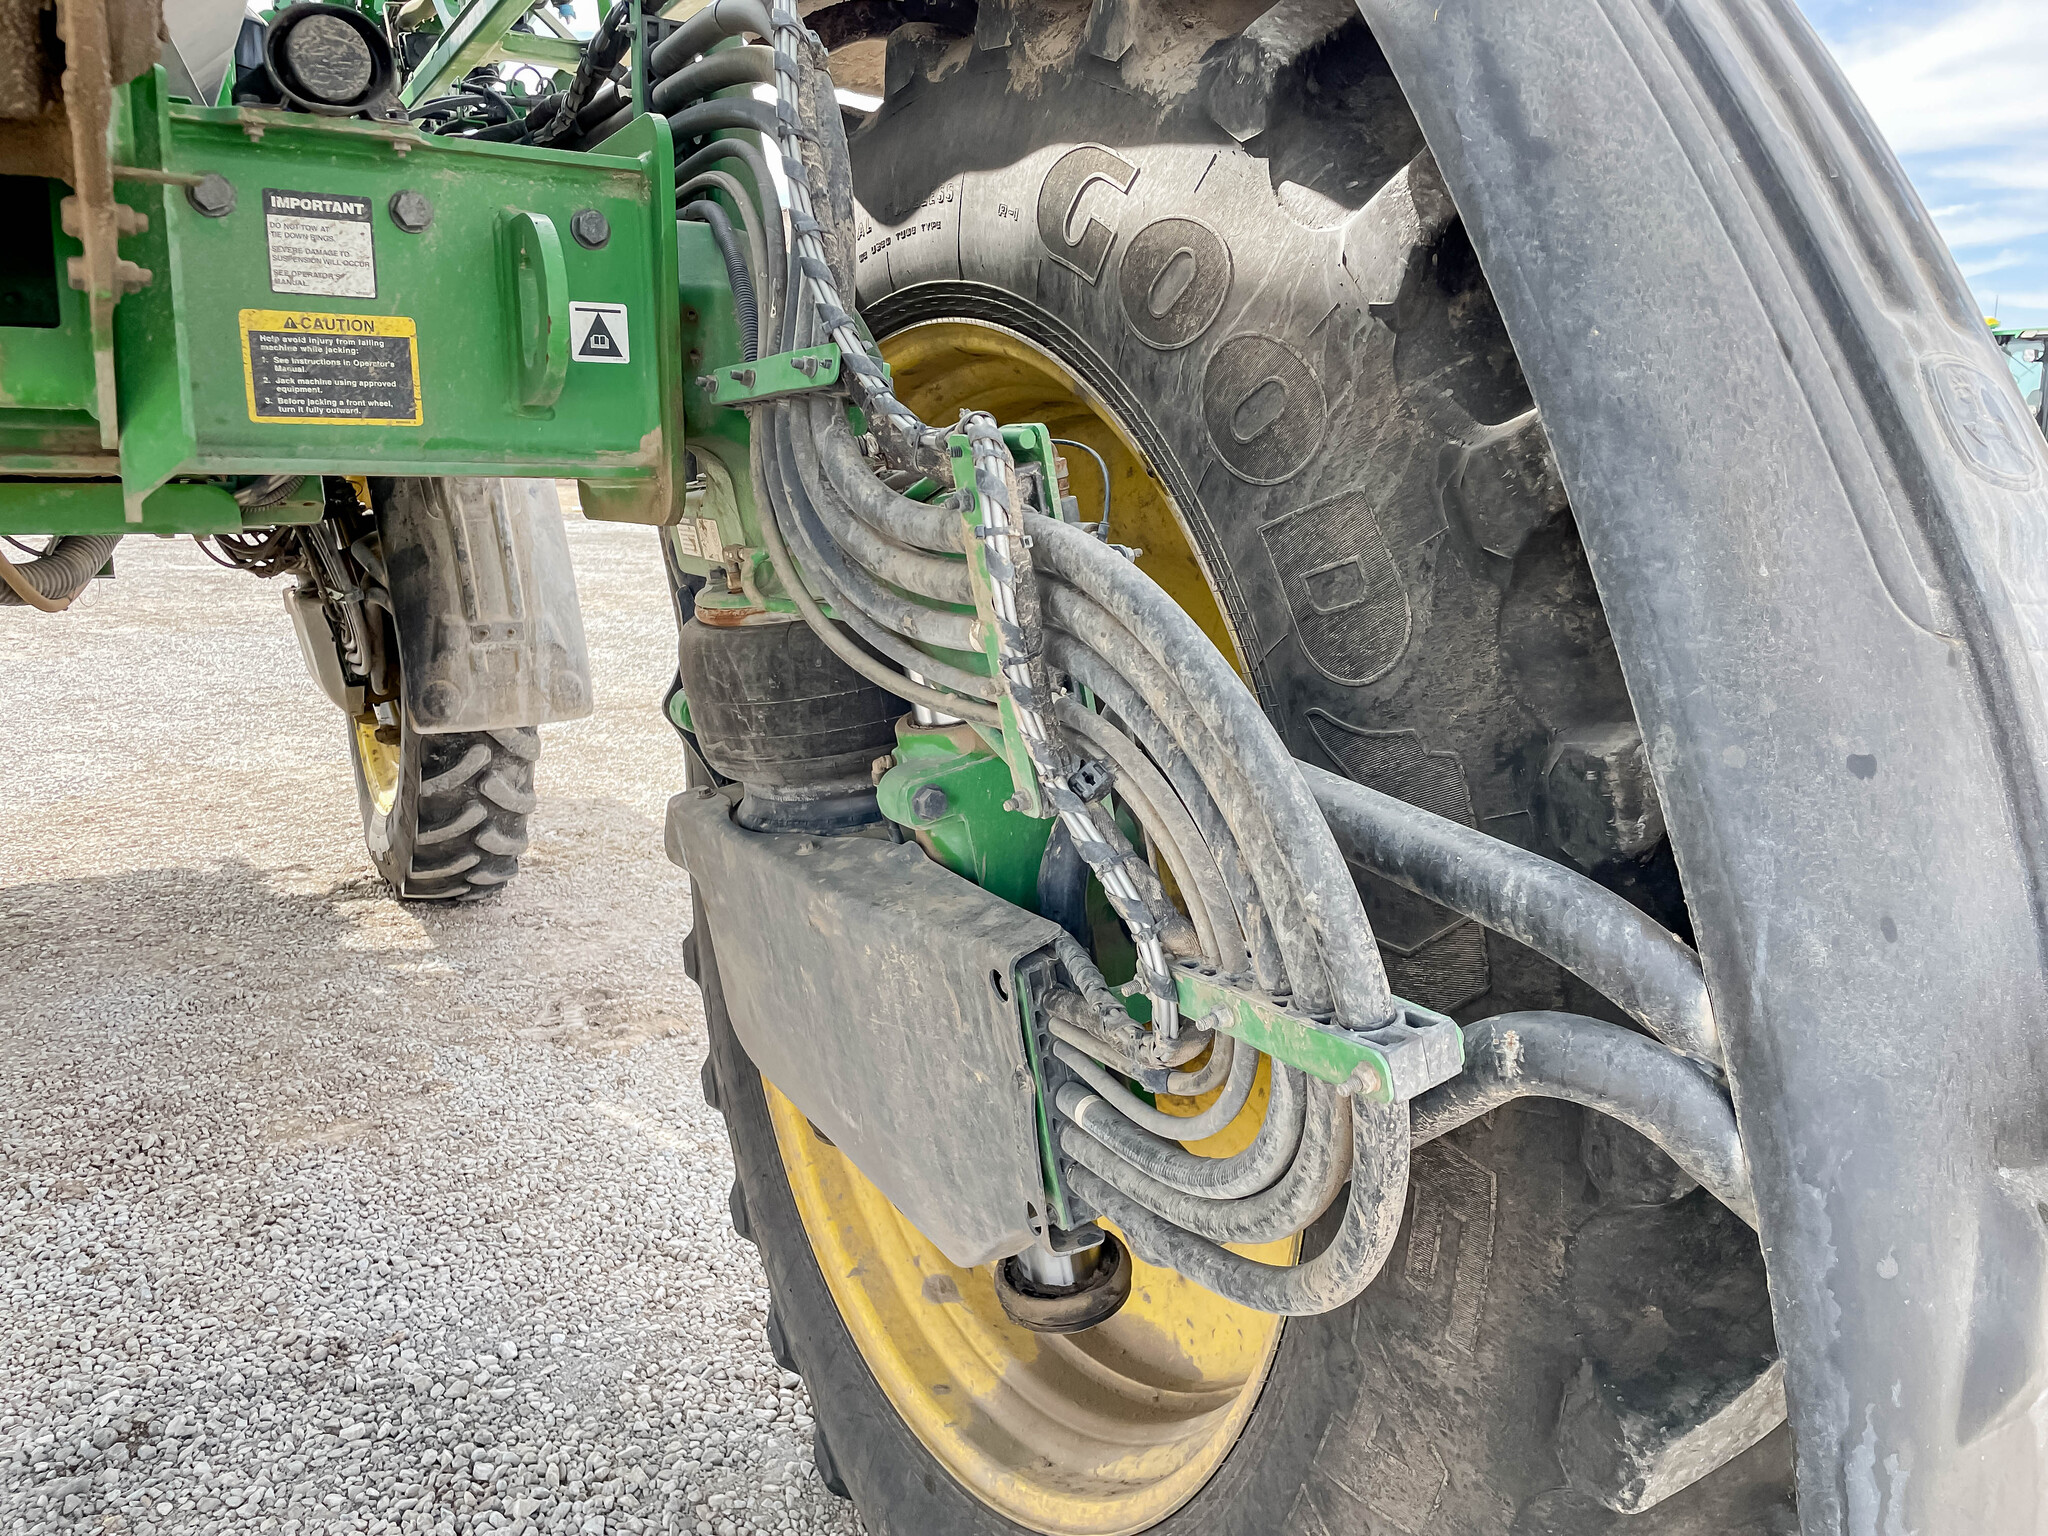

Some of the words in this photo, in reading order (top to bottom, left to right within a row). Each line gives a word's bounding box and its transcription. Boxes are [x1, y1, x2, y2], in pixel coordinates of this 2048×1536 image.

[270, 195, 364, 215] IMPORTANT
[998, 203, 1019, 222] R-1
[300, 224, 318, 232] TOW
[921, 220, 942, 232] TYPE
[271, 230, 282, 238] TIE
[284, 232, 309, 240] DOWN
[272, 246, 303, 254] SEVERE
[305, 249, 338, 257] DAMAGE
[340, 250, 350, 258] TO
[272, 254, 322, 264] SUSPENSION
[323, 258, 342, 266] WILL
[273, 269, 290, 277] SEE
[291, 270, 341, 280] OPERATOR'S
[300, 316, 374, 332] CAUTION
[260, 334, 280, 344] Help
[282, 336, 306, 344] avoid
[308, 336, 334, 346] injury
[336, 338, 356, 346] from
[358, 339, 384, 348] falling
[260, 344, 298, 352] machine
[326, 346, 359, 356] jacking:
[262, 356, 268, 364] 1.
[273, 356, 290, 364] See
[292, 358, 341, 366] instructions
[353, 360, 395, 368] Operator's
[274, 364, 308, 373] Manual.
[262, 376, 271, 384] 2.
[298, 378, 332, 386] machine
[334, 379, 357, 388] using
[358, 380, 396, 388] approved
[276, 386, 323, 394] equipment.
[308, 398, 338, 407] jacking
[368, 400, 394, 408] wheel,
[1037, 141, 1413, 687] GOOD
